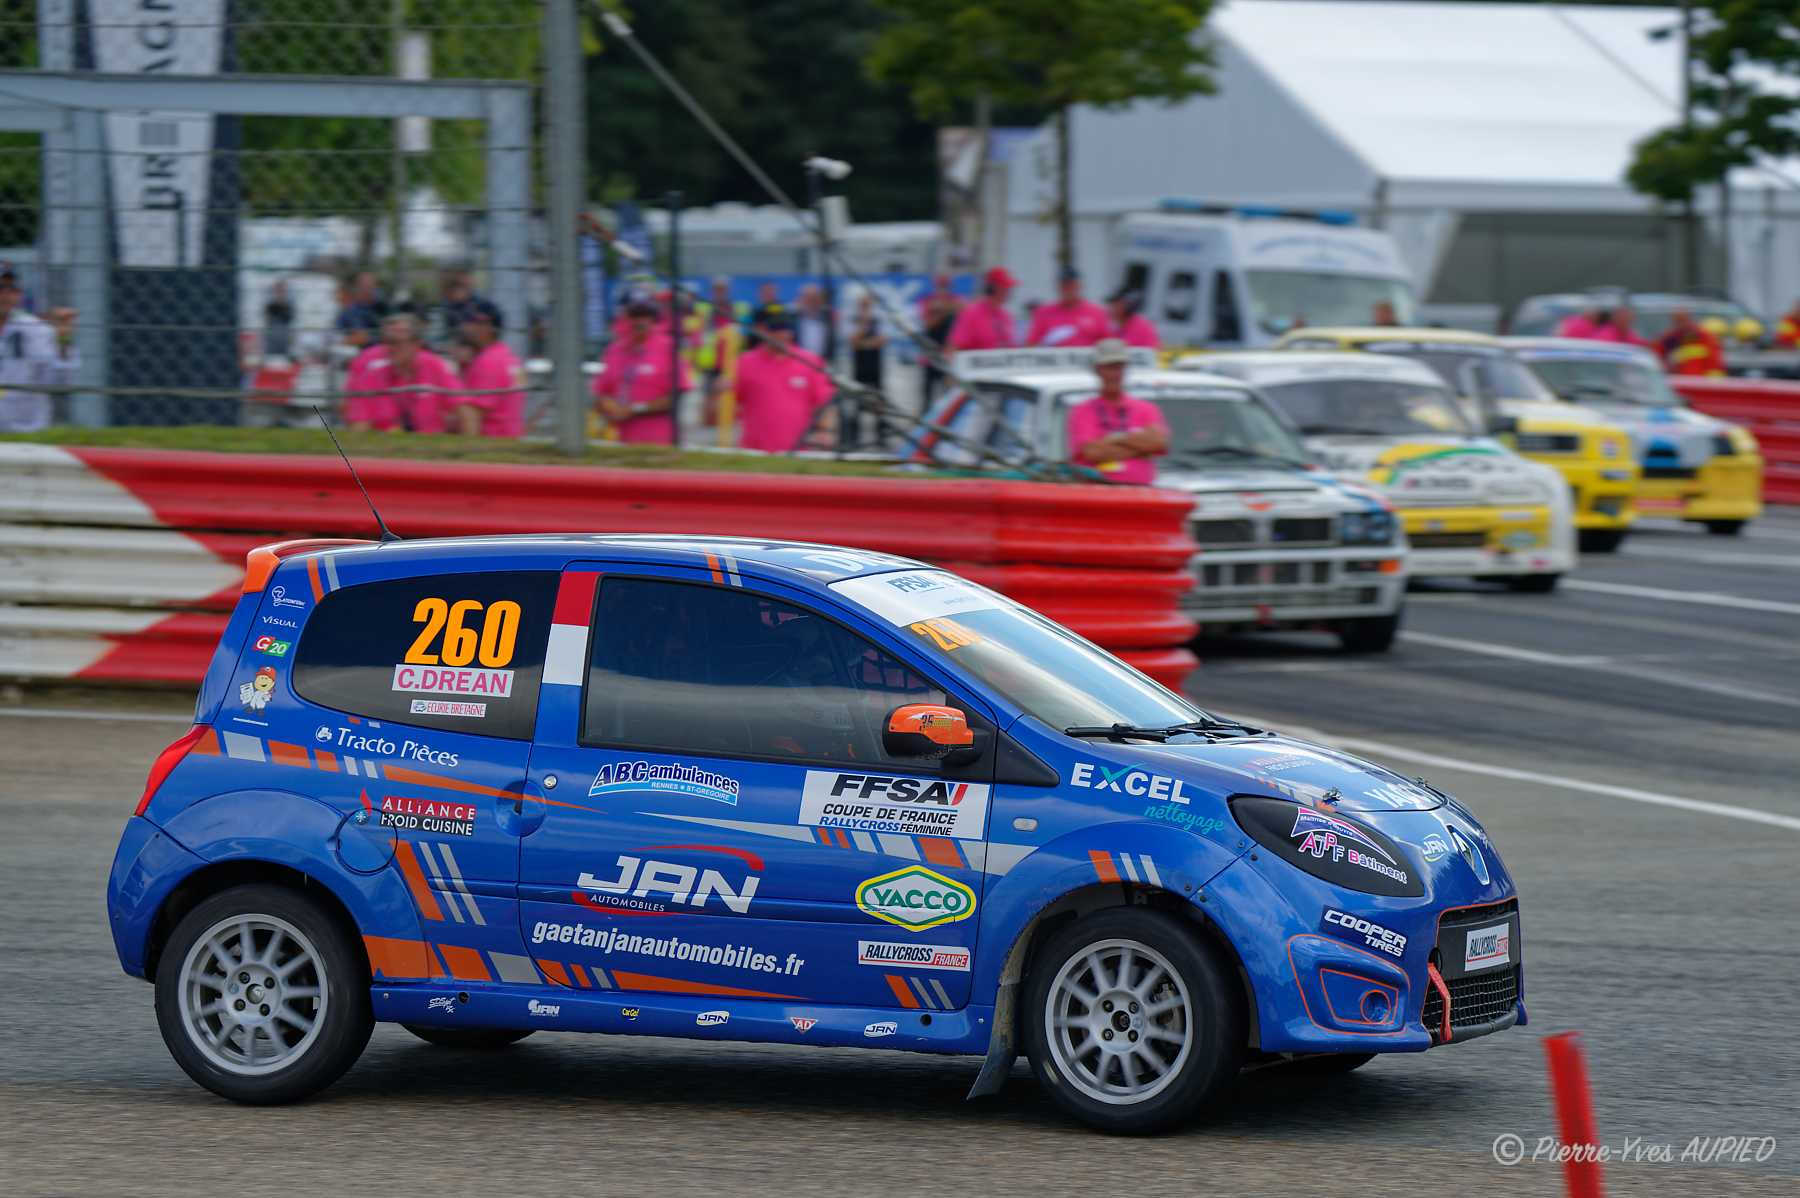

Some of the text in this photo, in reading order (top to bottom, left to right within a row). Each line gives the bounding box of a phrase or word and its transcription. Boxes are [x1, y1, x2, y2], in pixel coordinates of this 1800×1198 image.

[404, 597, 522, 668] 260
[397, 668, 509, 694] C.DREAN
[338, 727, 460, 767] Tracto Pièces
[649, 763, 740, 795] ambulances
[830, 774, 950, 806] FFSA
[1070, 762, 1191, 805] EXCEL
[380, 813, 473, 836] FROID CUISINE
[819, 816, 953, 836] RALLYCROSS FÉMININE
[822, 803, 958, 825] COUPE DE FRANCE
[1143, 802, 1225, 834] nettoyage
[577, 855, 761, 914] JAN
[590, 894, 665, 912] AUTOMOBILES
[872, 888, 961, 911] YACCO
[1324, 909, 1407, 948] COOPER
[531, 920, 805, 976] gaetanjanautomobiles.fr
[865, 944, 968, 968] RALLYCROSS FRANCE
[1365, 935, 1404, 957] TIRES
[697, 1014, 729, 1023] JAN
[865, 1025, 896, 1034] JAN
